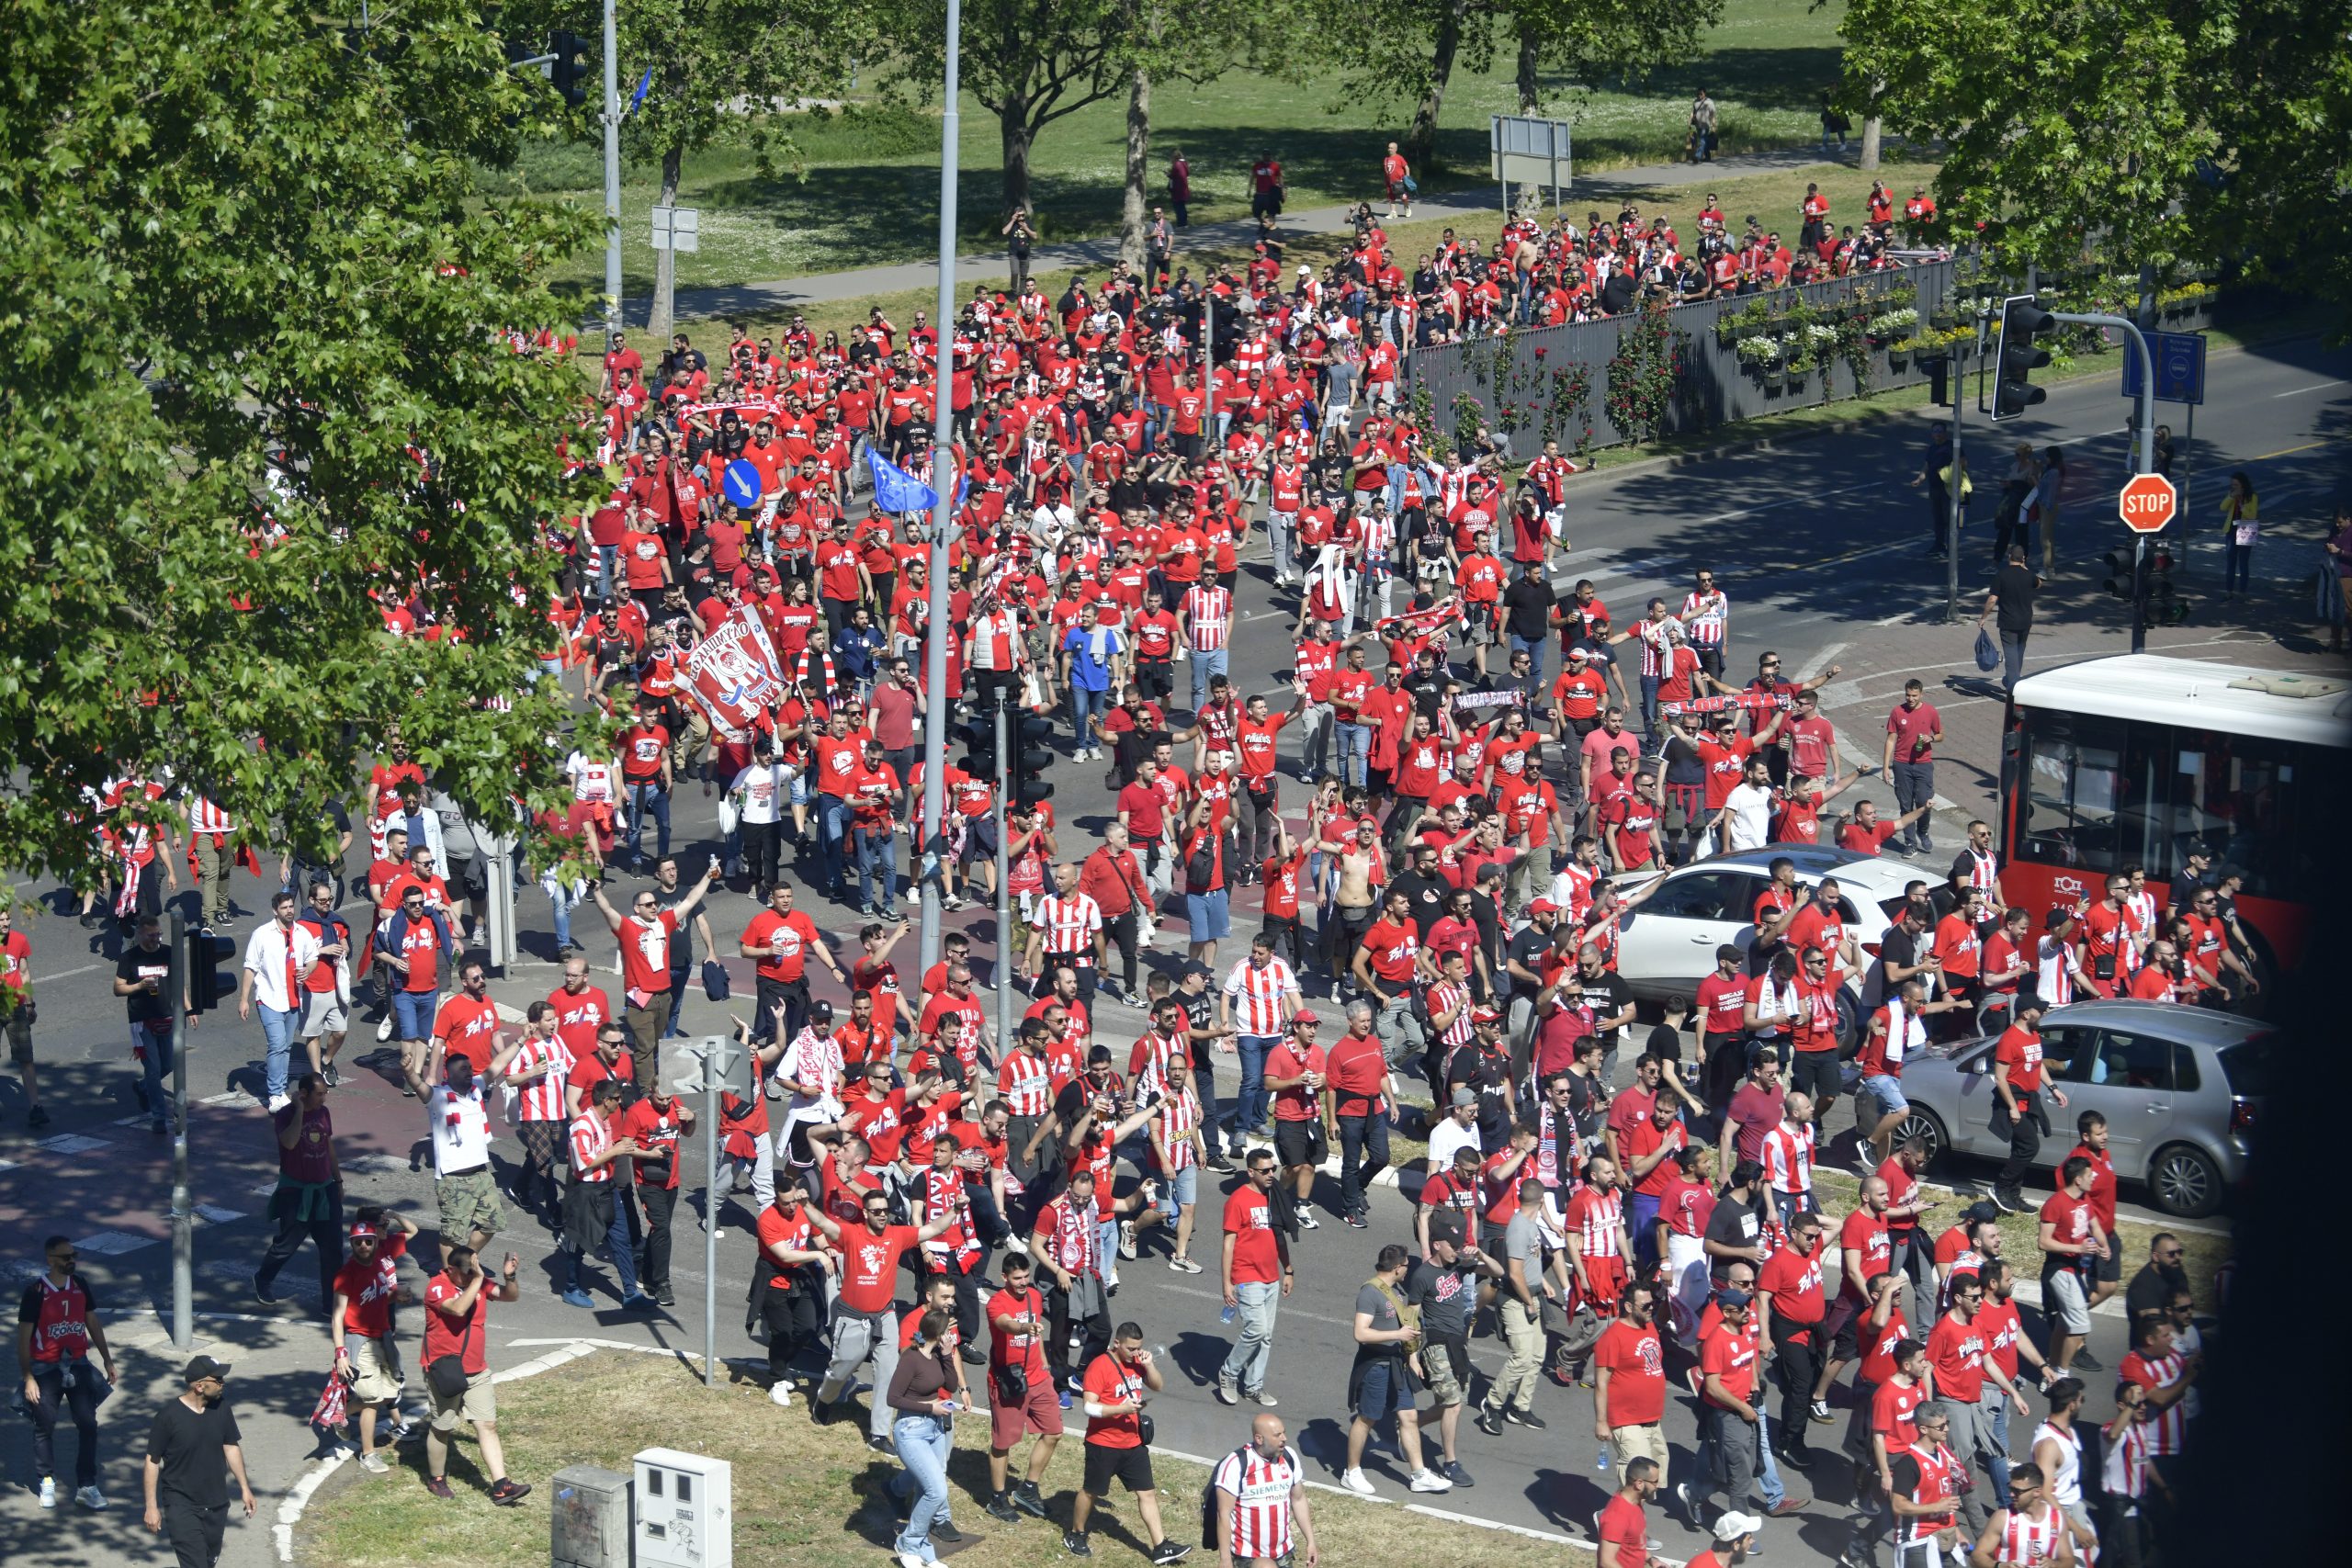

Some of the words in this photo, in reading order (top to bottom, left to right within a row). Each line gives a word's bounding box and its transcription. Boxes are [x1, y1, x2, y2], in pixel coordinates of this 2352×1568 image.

[1285, 479, 1293, 490] 5
[1409, 477, 1416, 486] 7
[1278, 489, 1299, 501] bwin
[2126, 493, 2170, 513] STOP
[1457, 693, 1486, 710] PATRA
[1245, 734, 1272, 744] PIRAEUS
[1607, 789, 1634, 800] ΟΛΥΜΠΙΑΚ
[1518, 796, 1546, 807] PIRAUS
[943, 1192, 955, 1208] 15
[431, 1285, 443, 1299] 7
[59, 1300, 66, 1316] 7
[1249, 1482, 1290, 1496] SIEMENS
